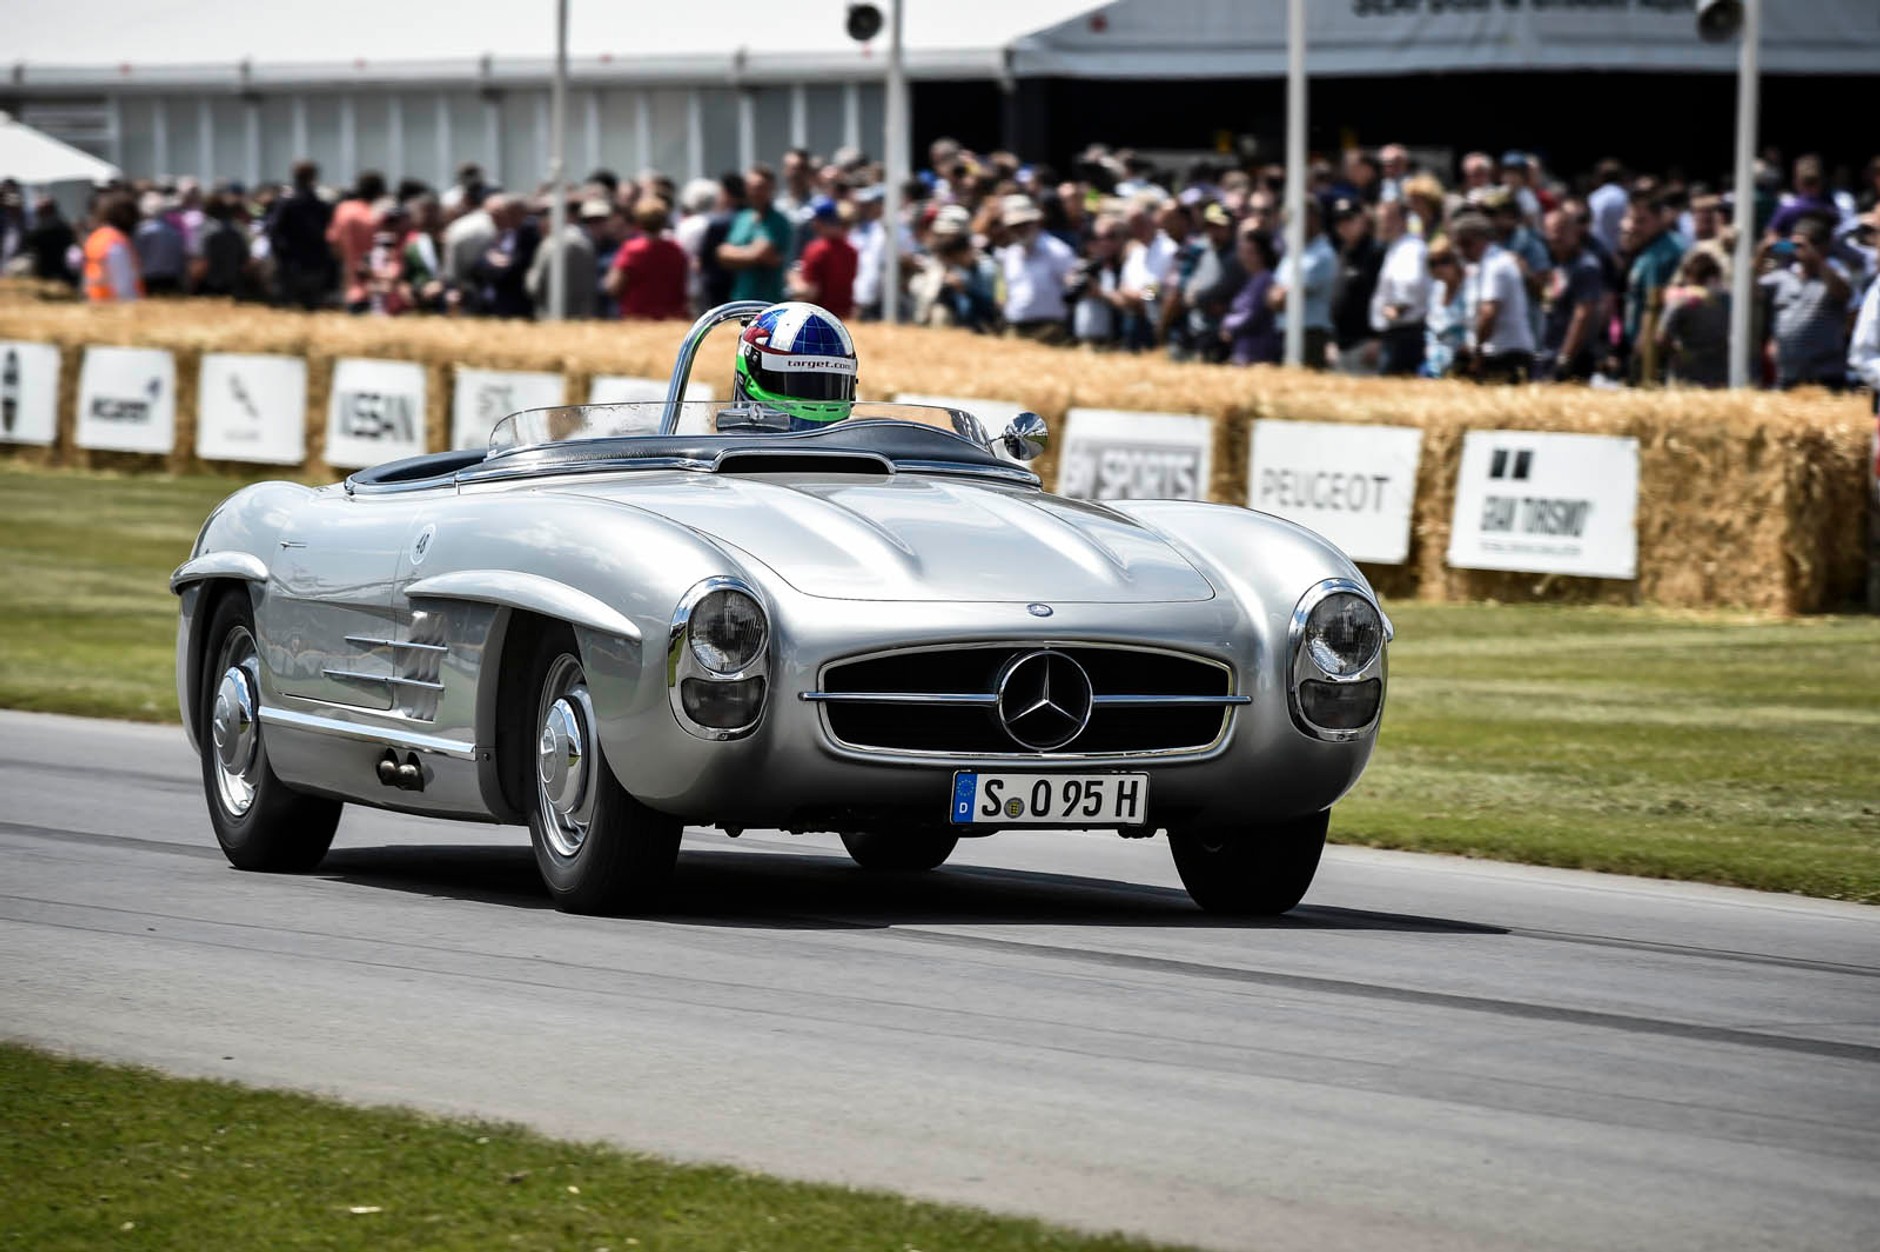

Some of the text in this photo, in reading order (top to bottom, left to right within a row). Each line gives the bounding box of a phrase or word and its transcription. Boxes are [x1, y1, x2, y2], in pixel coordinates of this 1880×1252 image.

[1261, 468, 1390, 513] PEUGEOT
[959, 802, 968, 814] D
[981, 779, 1004, 817] S
[1115, 780, 1139, 818] H
